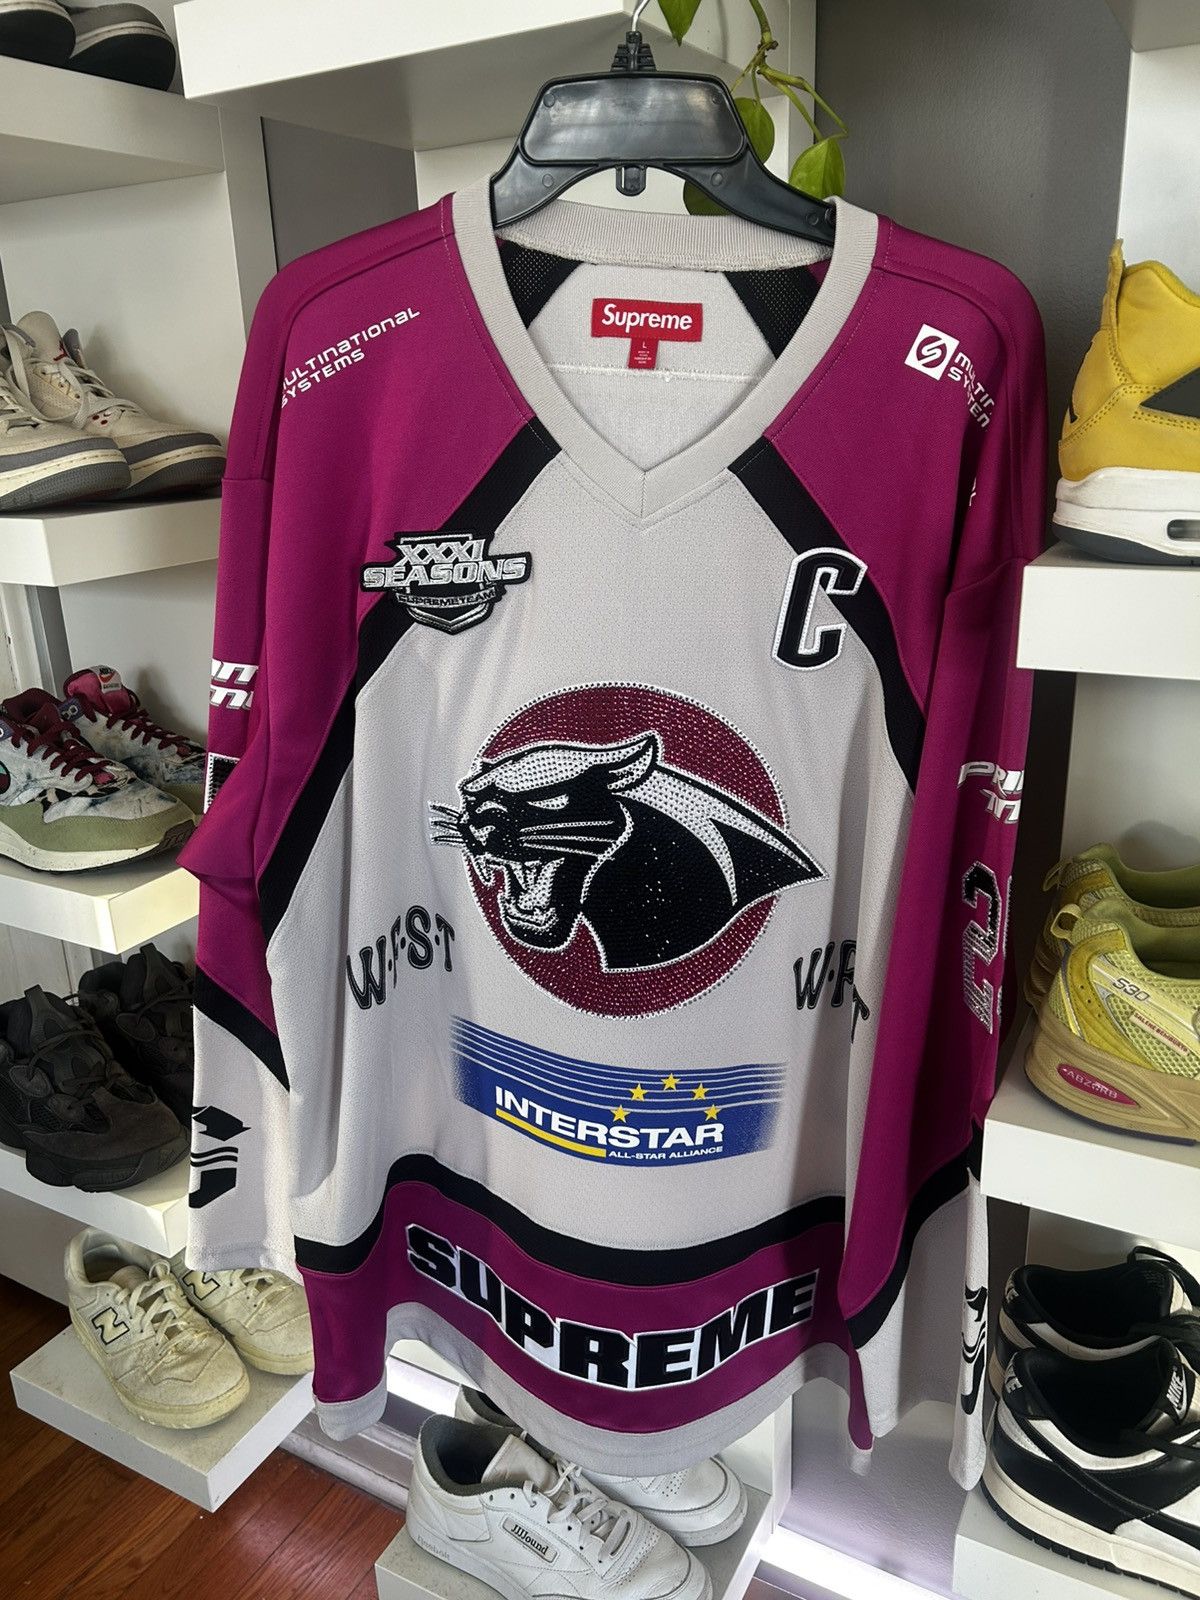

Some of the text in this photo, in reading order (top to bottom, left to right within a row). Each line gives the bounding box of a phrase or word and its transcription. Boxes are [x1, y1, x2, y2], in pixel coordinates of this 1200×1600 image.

[601, 303, 693, 333] Supreme
[283, 307, 421, 390] ULTINATIONAL
[394, 538, 486, 568] XXXI
[362, 556, 528, 589] SEASONS
[771, 546, 869, 671] C
[1112, 977, 1151, 1002] 530
[495, 1085, 725, 1150] INTERSTAR
[608, 1145, 724, 1160] ALL-STAR ALLIANCE
[404, 1222, 820, 1392] SUPREME
[1166, 1370, 1184, 1408] NIKE
[510, 1524, 550, 1556] JJJJound
